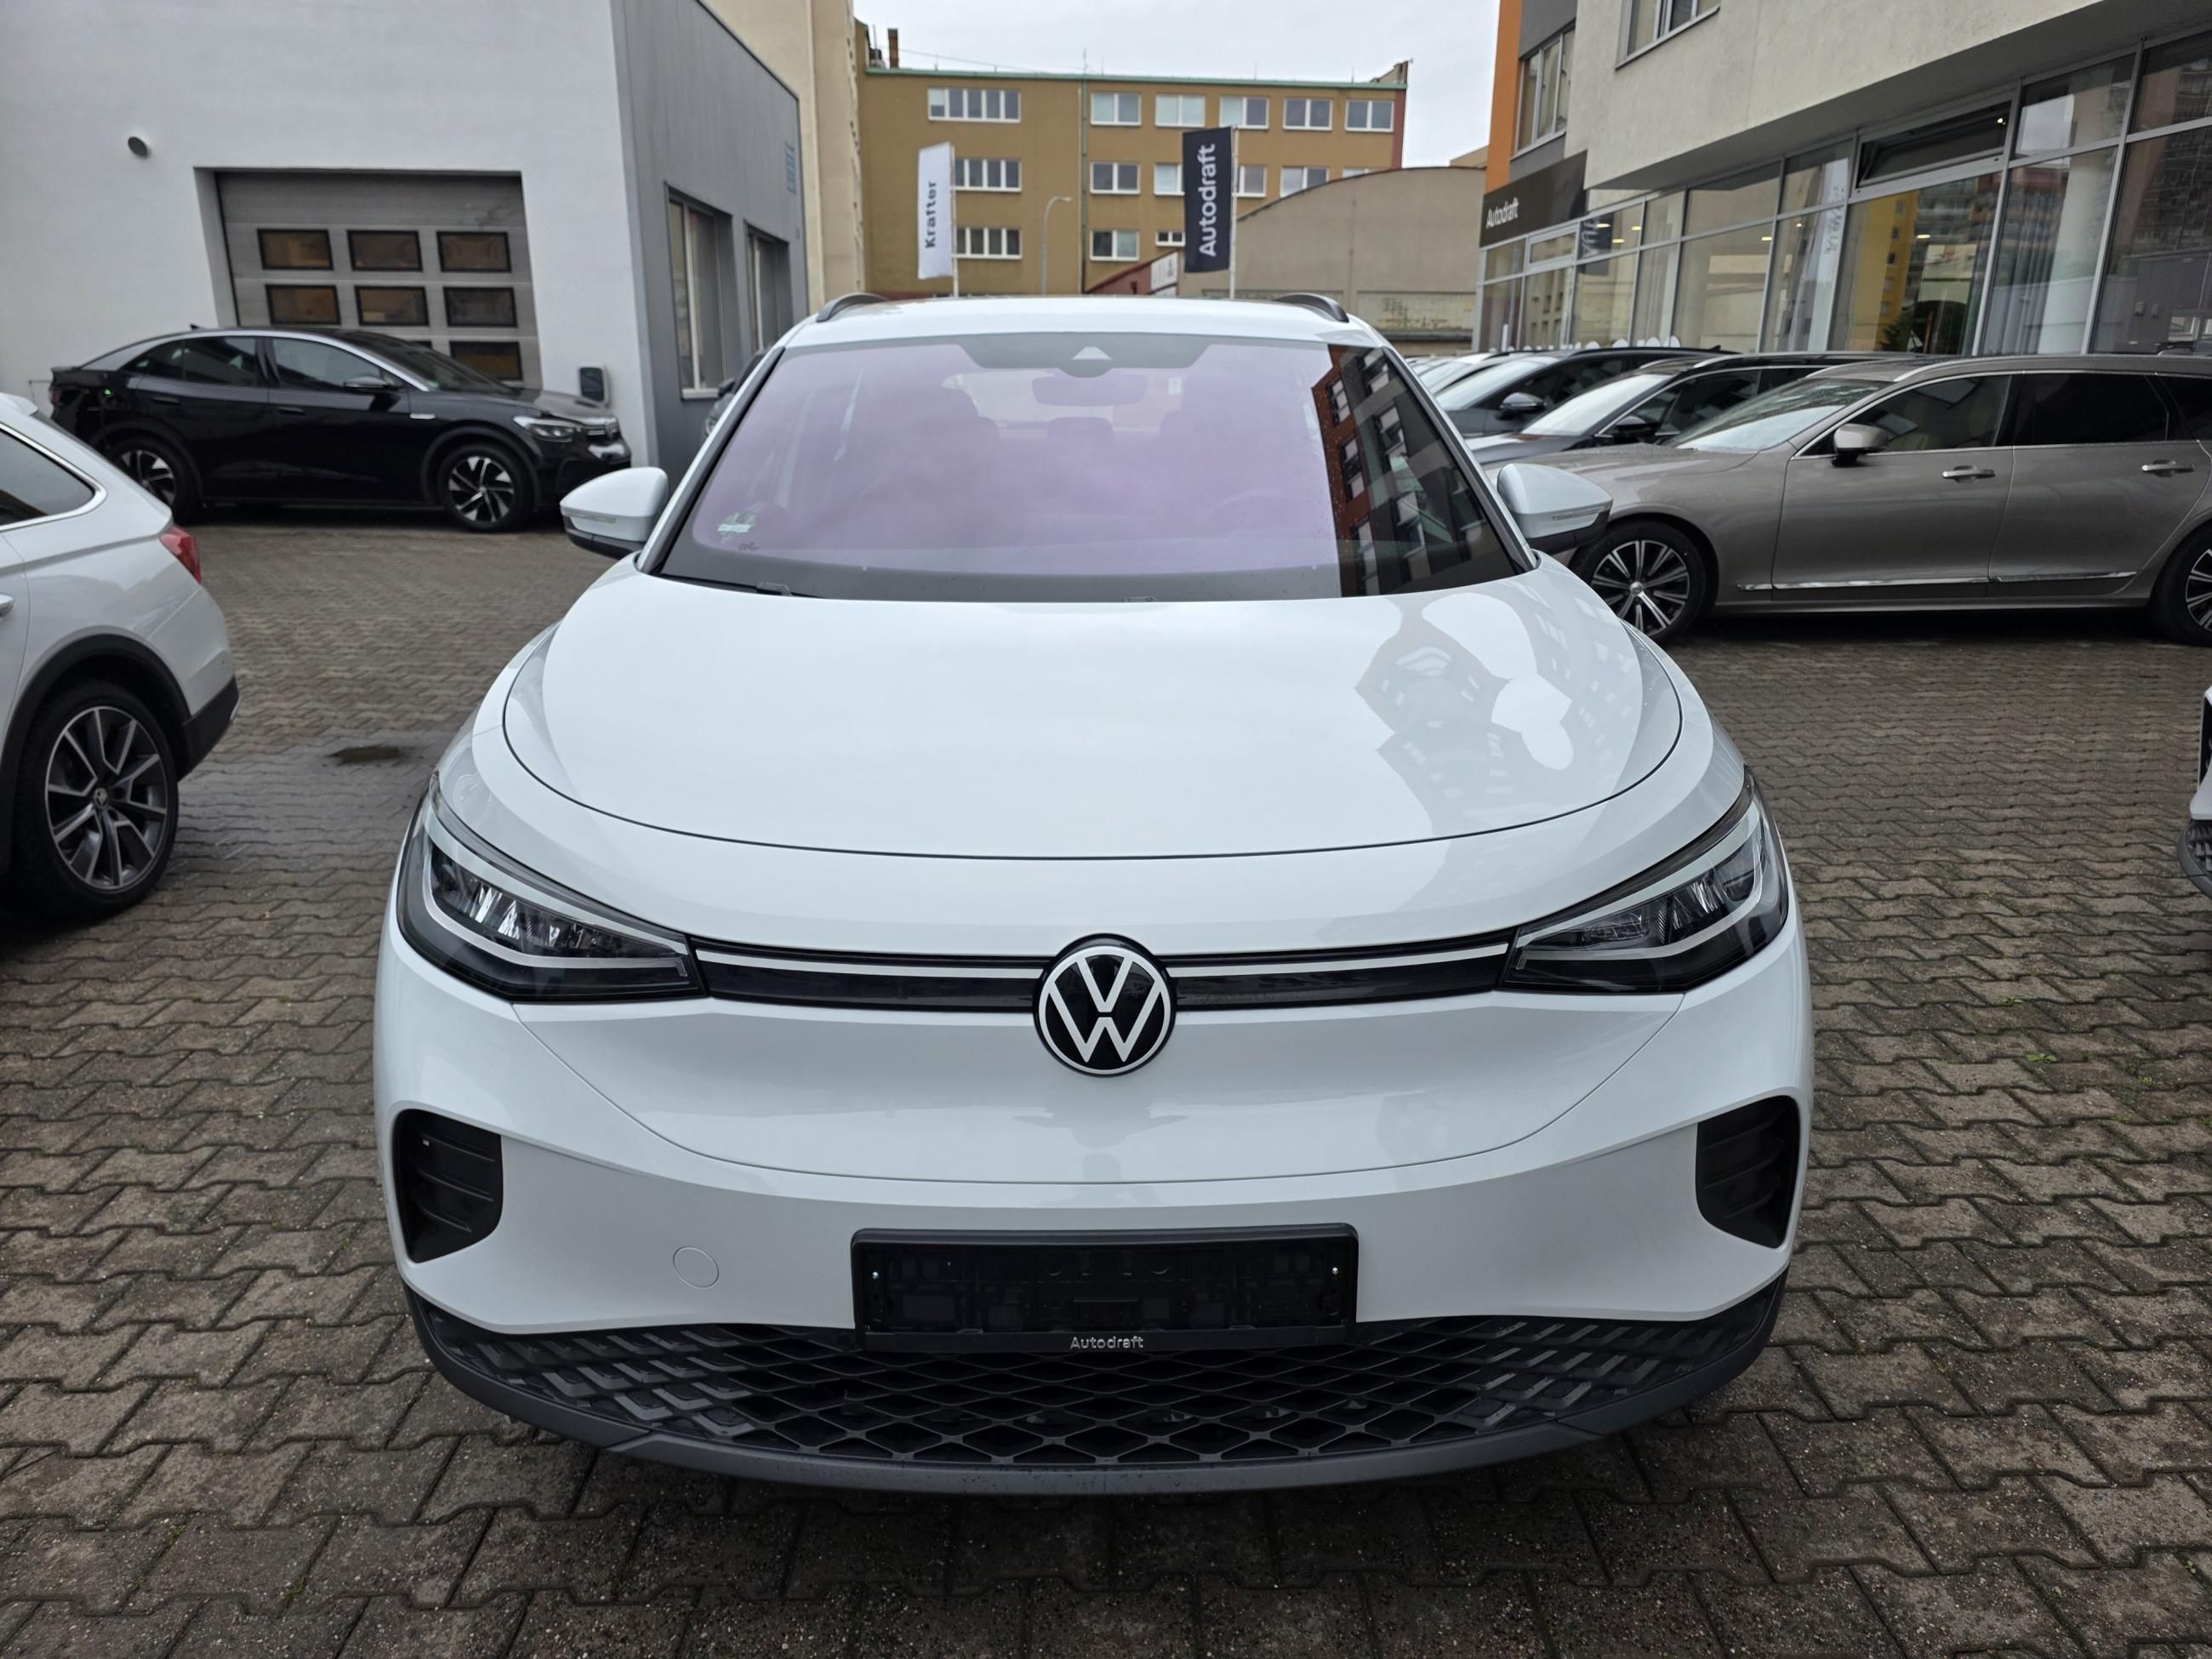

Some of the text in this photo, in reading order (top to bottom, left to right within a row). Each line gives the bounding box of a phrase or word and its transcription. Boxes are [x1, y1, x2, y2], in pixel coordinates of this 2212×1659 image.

[925, 181, 937, 248] Krafter
[1197, 144, 1217, 257] Autodraft
[1485, 197, 1519, 229] Autodraft
[1043, 952, 1166, 1063] VW
[1069, 1335, 1143, 1349] Autodraft
